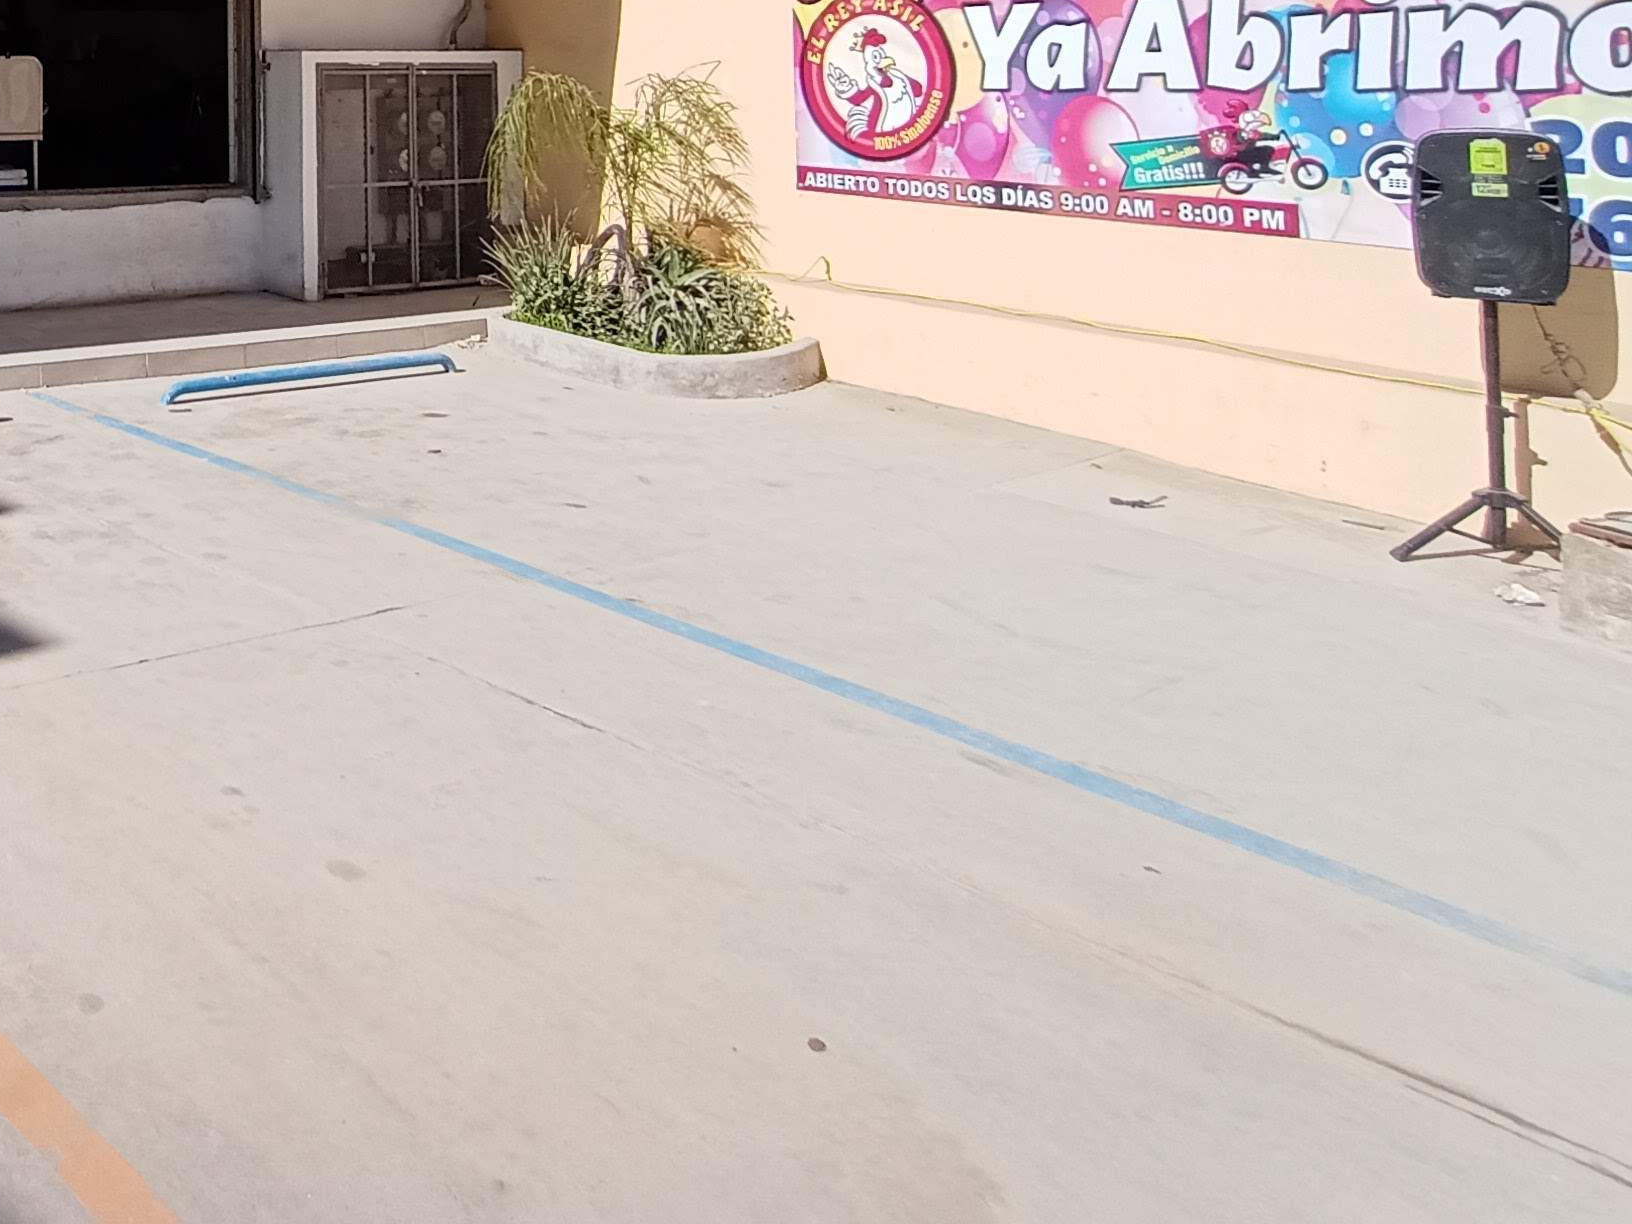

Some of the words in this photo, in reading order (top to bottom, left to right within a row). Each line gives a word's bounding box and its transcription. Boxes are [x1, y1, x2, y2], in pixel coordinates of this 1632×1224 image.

[807, 33, 825, 65] EL
[962, 0, 1090, 92] Ya
[873, 133, 902, 150] 100%
[1133, 162, 1205, 184] Gratis!!!
[805, 172, 880, 193] ABIERTO
[884, 178, 950, 199] TODOS
[956, 185, 996, 205] LOS
[1002, 185, 1053, 209] DÍAS
[1060, 191, 1109, 214] 9:00
[1116, 197, 1154, 218] AM
[1178, 203, 1234, 225] 8:00
[1242, 208, 1285, 230] PM
